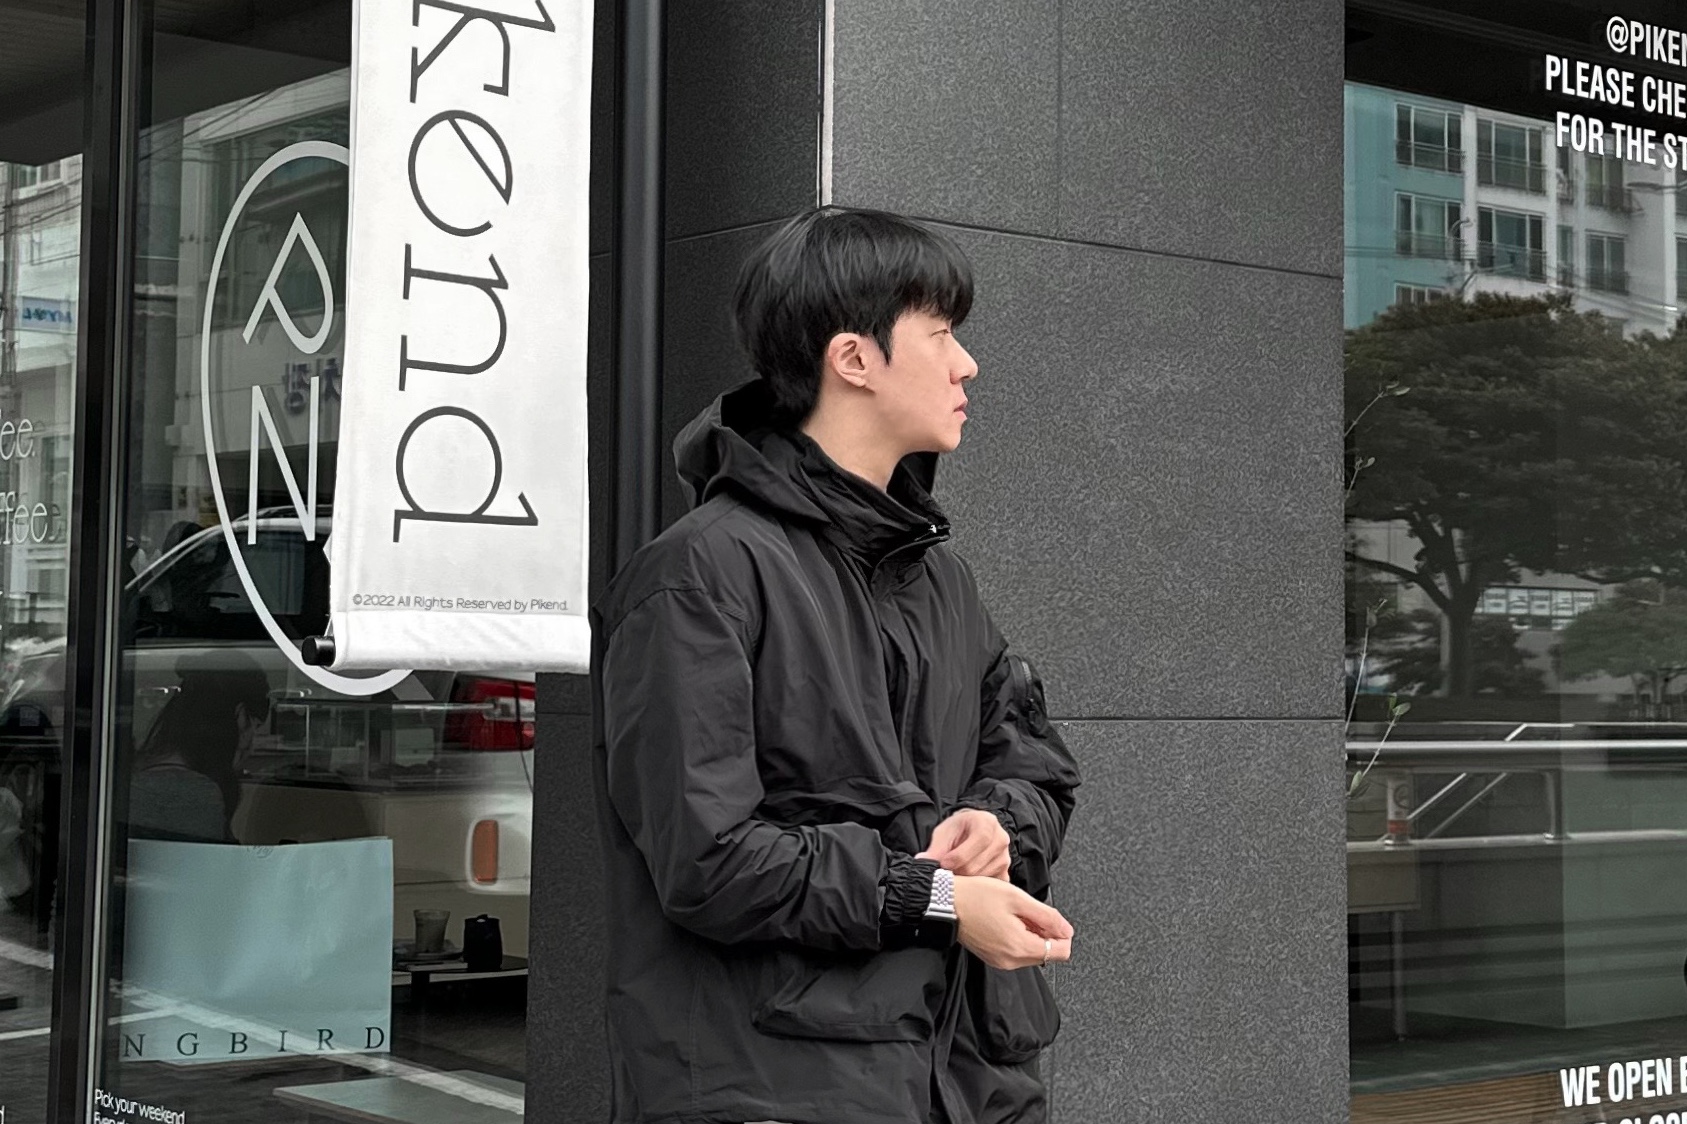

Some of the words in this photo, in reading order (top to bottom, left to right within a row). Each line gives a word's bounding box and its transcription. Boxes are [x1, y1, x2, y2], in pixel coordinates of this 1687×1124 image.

[1545, 54, 1635, 108] PLEASE
[1556, 111, 1605, 156] FOR
[1611, 122, 1656, 165] THE
[397, 596, 411, 607] All
[413, 596, 454, 611] Rights
[456, 598, 511, 610] Reserved
[514, 600, 528, 613] by
[95, 1088, 114, 1109] Pick
[114, 1099, 138, 1115] your
[1560, 1065, 1601, 1108] WE
[1607, 1057, 1673, 1103] OPEN
